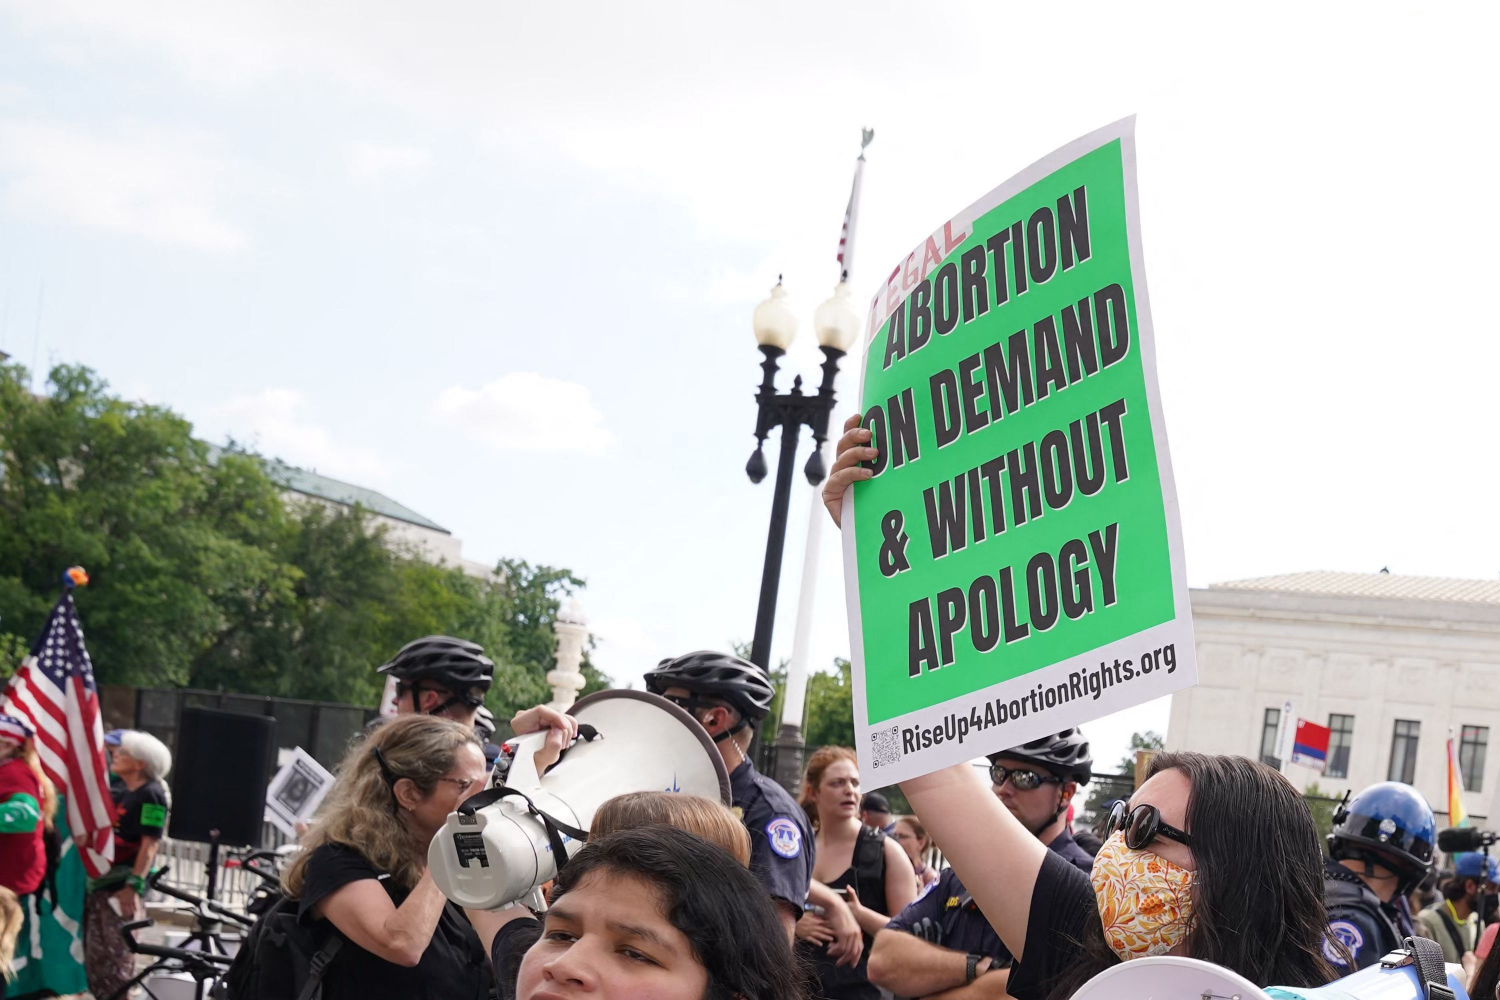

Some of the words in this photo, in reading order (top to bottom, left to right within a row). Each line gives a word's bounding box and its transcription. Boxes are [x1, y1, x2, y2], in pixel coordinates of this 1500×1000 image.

[883, 184, 1091, 371] ABORTION
[862, 387, 920, 478] ON
[929, 283, 1130, 449] DEMAND
[879, 509, 910, 578] &
[922, 398, 1130, 560] WITHOUT
[908, 522, 1119, 679] APOLOGY
[902, 643, 1177, 755] RiseUp4AbortionRights.org
